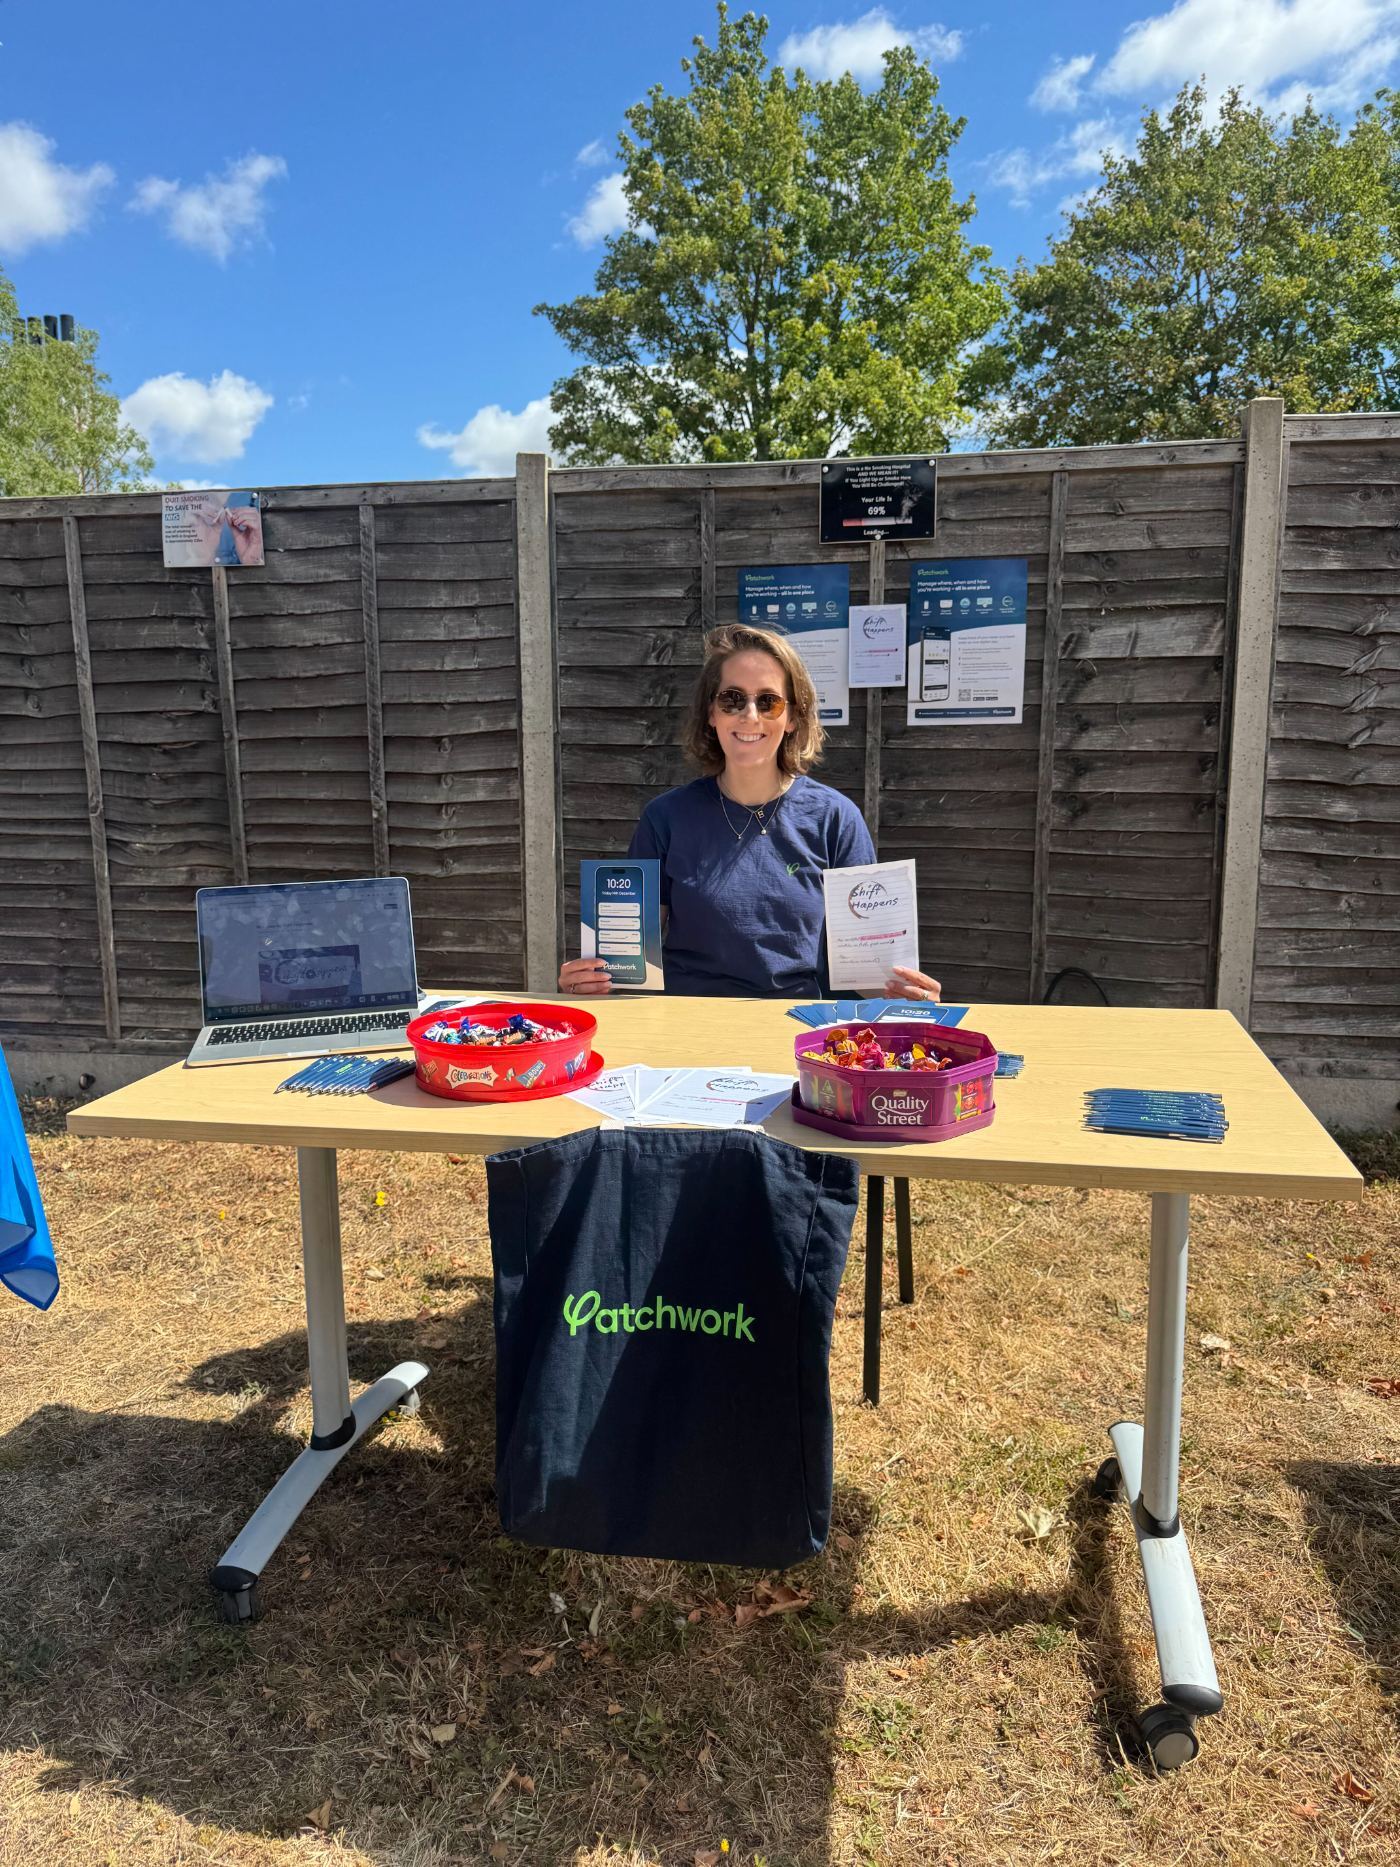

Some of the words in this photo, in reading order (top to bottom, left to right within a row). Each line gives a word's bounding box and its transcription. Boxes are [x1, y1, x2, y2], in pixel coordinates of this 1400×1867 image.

[868, 507, 886, 515] 69%
[864, 617, 884, 627] Shift
[606, 878, 631, 889] 10:20
[852, 883, 881, 899] Shift
[852, 898, 899, 910] Happens
[603, 962, 637, 970] Patchwork
[872, 1096, 929, 1115] Quality
[877, 1111, 922, 1125] Street
[563, 1290, 755, 1342] Patchwork
